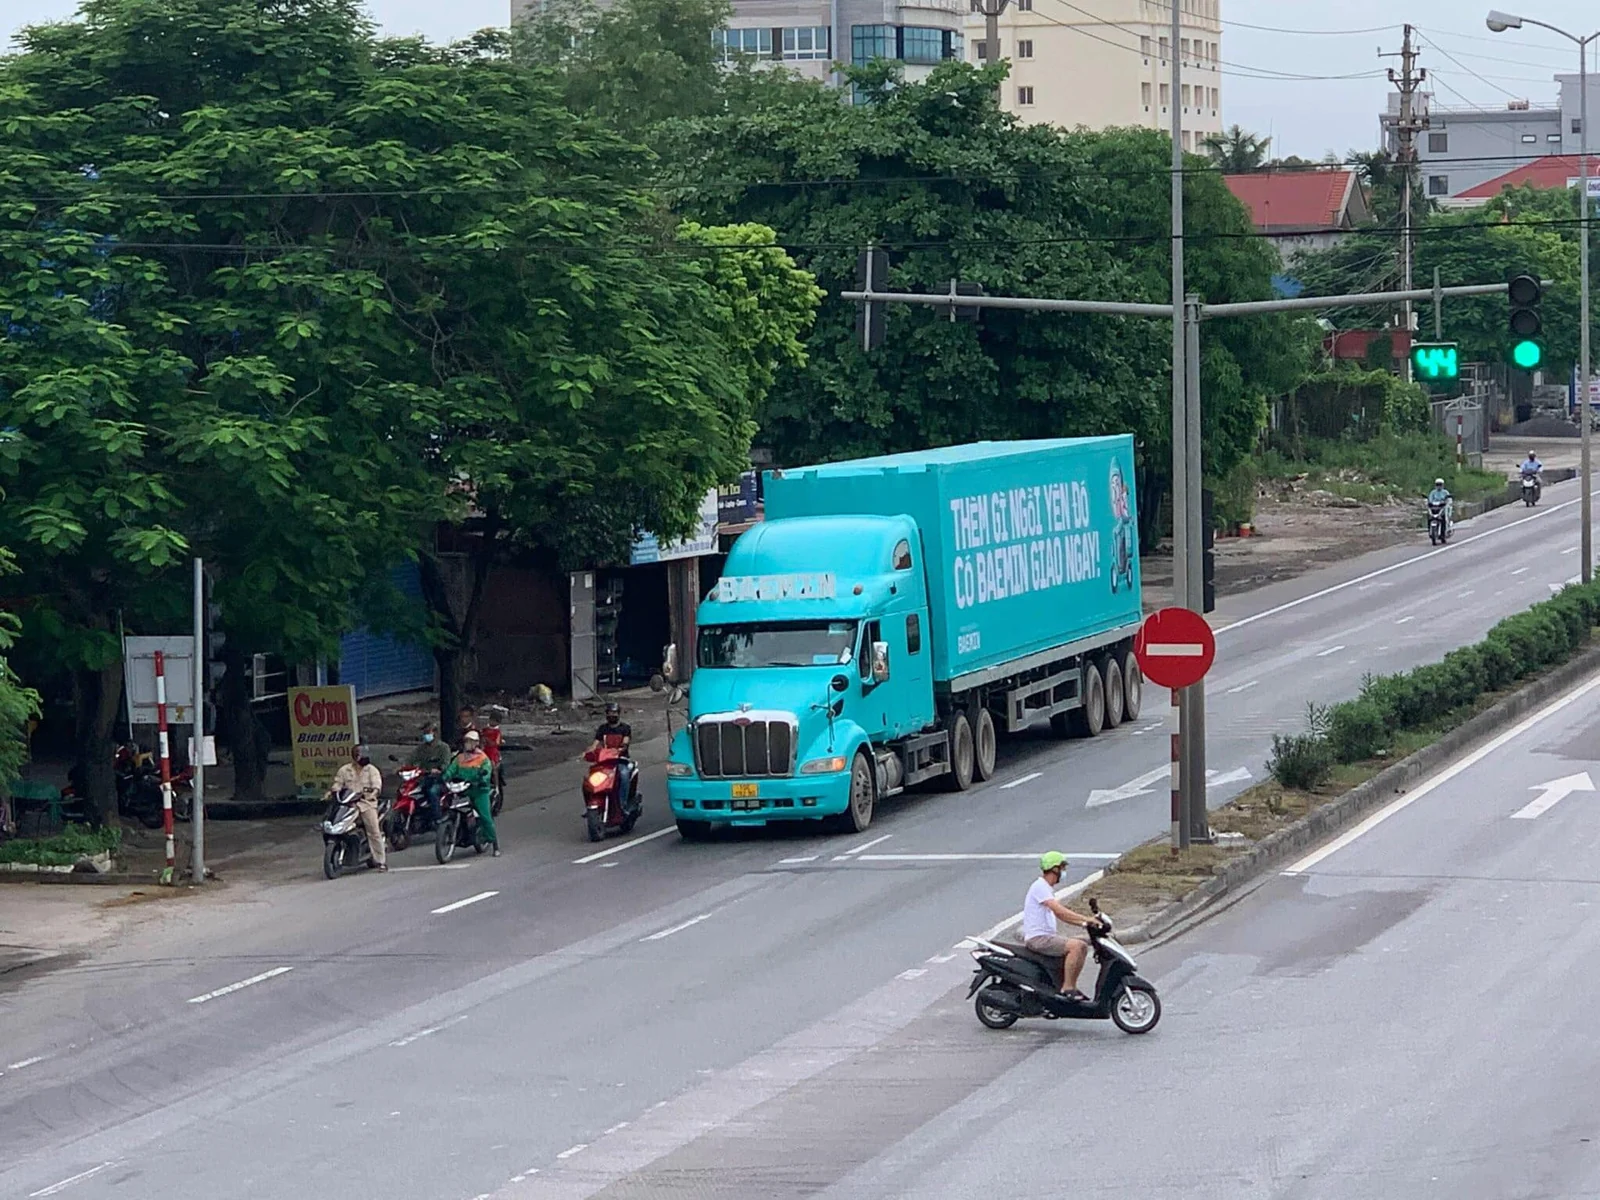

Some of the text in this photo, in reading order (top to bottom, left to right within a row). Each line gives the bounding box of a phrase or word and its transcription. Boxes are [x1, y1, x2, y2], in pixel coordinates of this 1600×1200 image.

[1416, 348, 1457, 377] 44
[991, 491, 1009, 543] GÌ
[1072, 480, 1090, 528] ĐÓ
[954, 531, 1101, 610] CÓ BAEMIN GIAO NGAY!
[718, 573, 836, 602] BAEMIN
[301, 746, 323, 757] BIA
